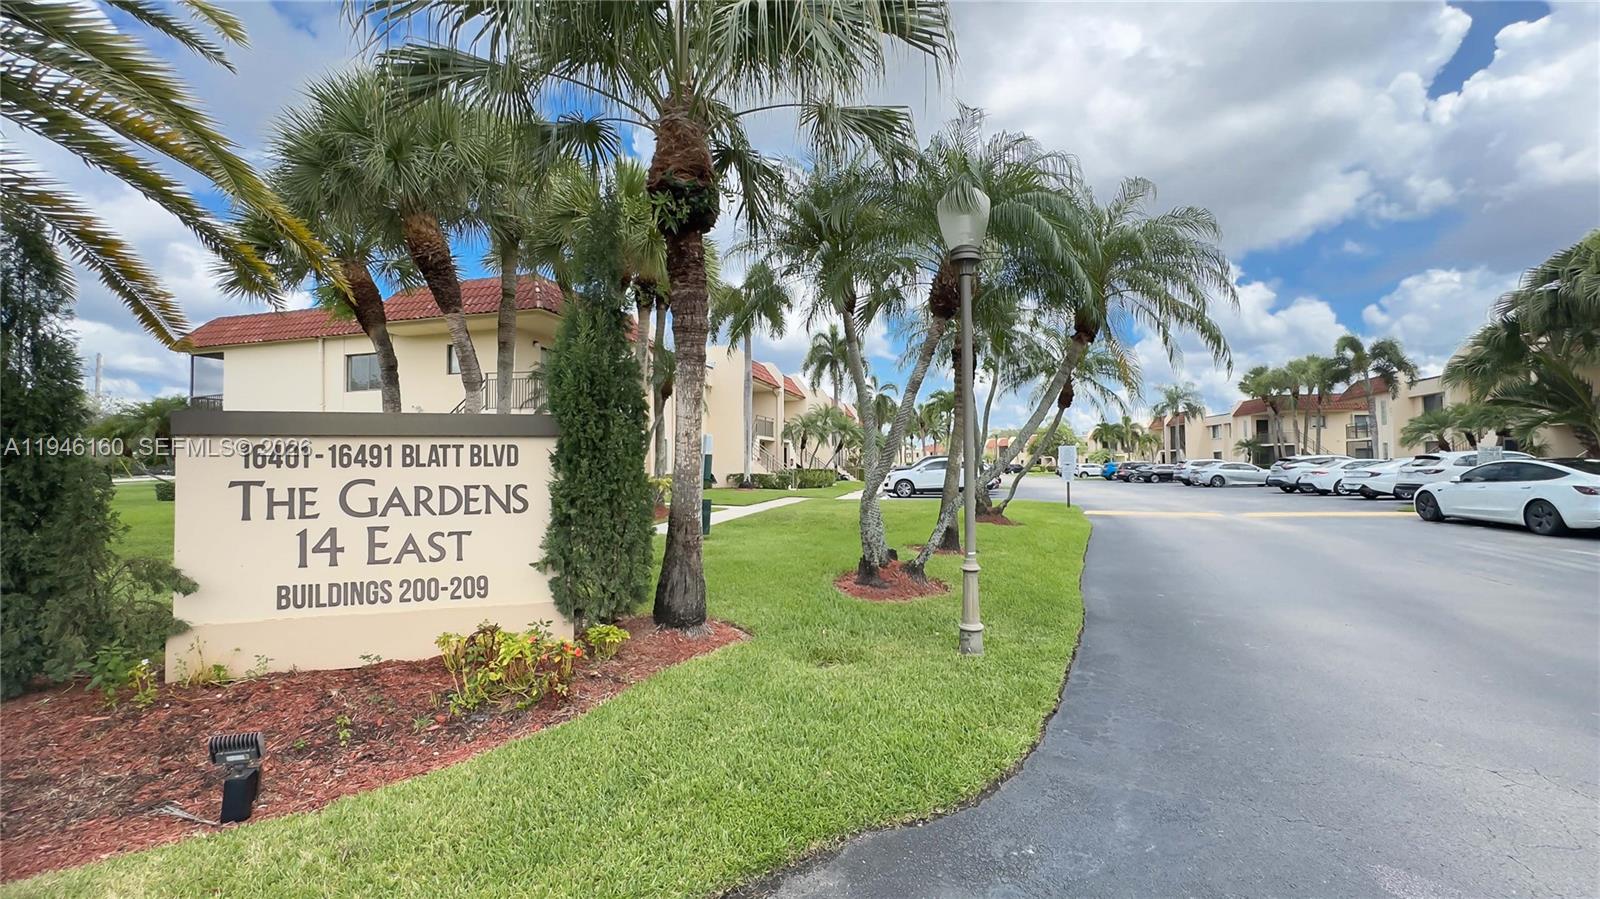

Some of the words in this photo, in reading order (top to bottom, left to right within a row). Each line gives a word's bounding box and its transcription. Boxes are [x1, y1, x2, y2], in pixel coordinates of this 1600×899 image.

[401, 444, 465, 468] BLATT
[469, 444, 519, 467] BLVD
[296, 526, 345, 569] 14
[276, 579, 394, 610] BUILDINGS
[399, 575, 489, 602] 200-209
